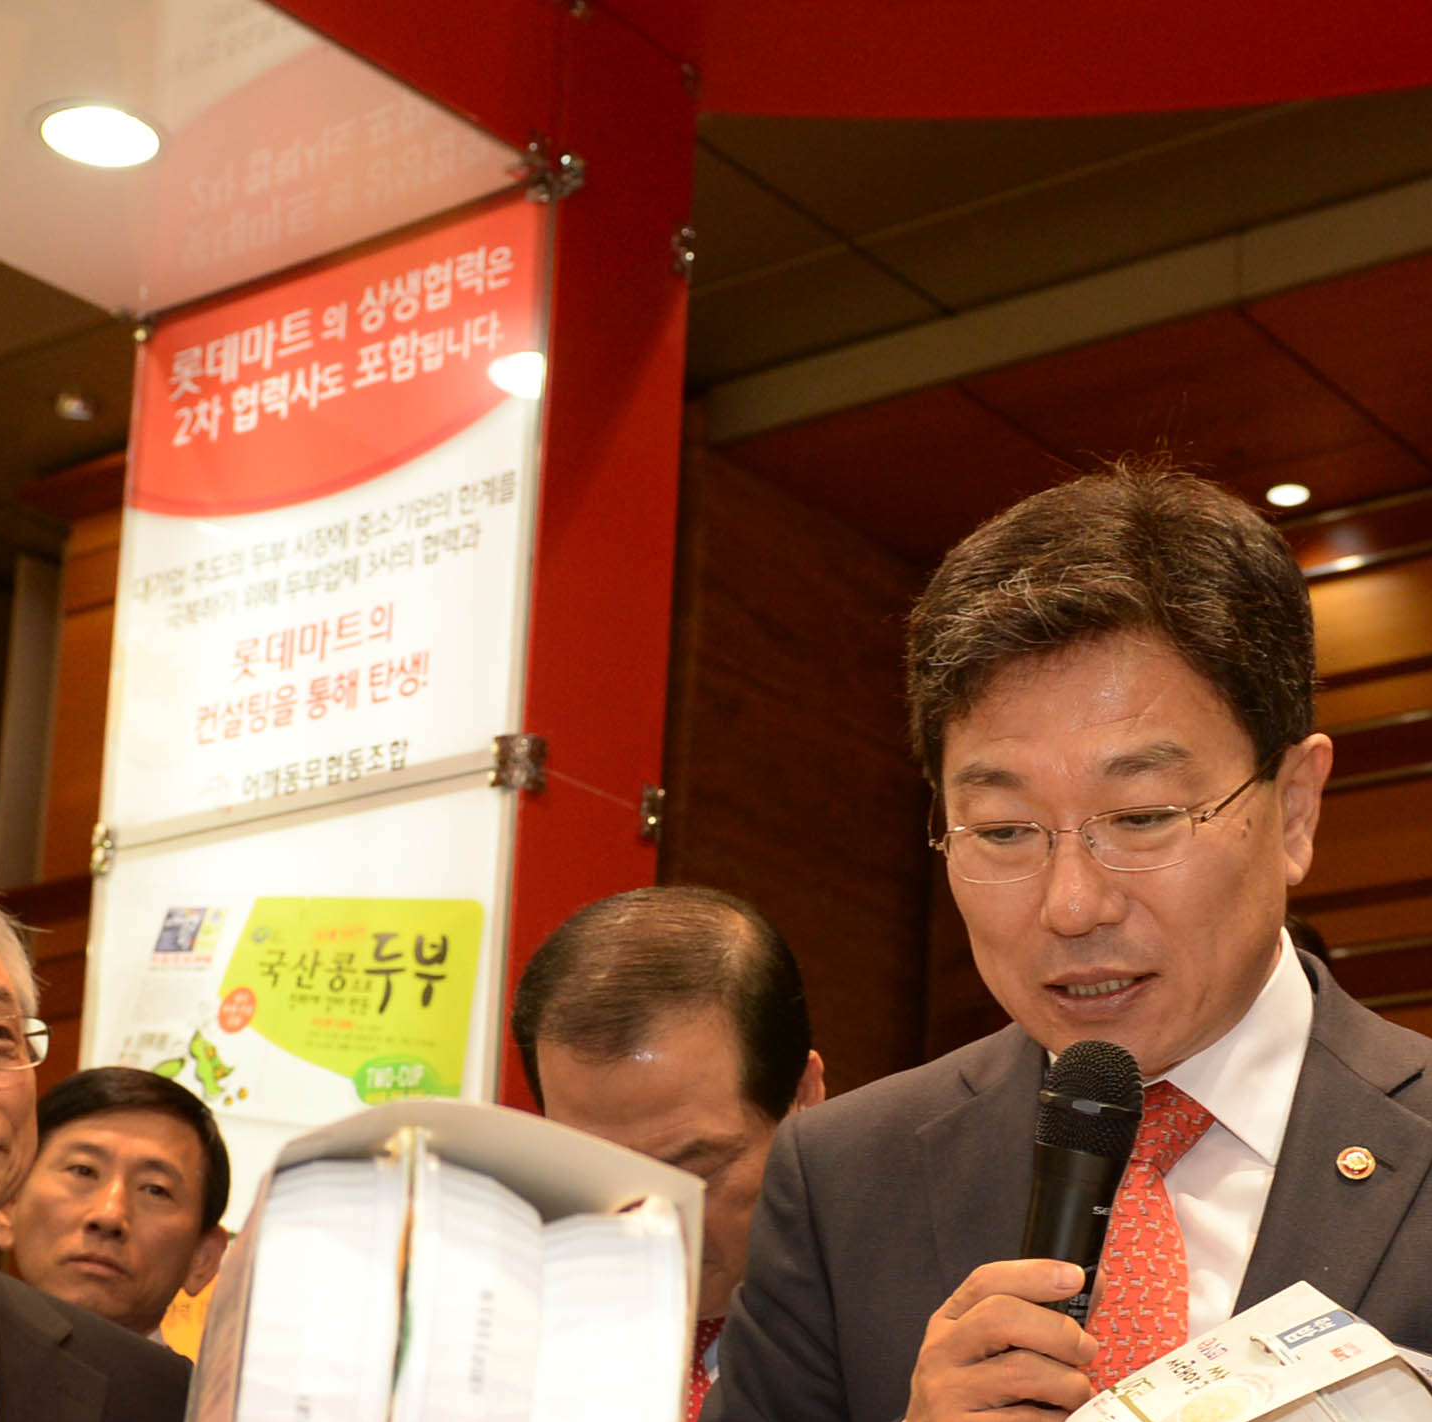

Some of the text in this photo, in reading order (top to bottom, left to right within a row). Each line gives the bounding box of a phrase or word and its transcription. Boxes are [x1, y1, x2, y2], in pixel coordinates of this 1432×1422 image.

[170, 246, 515, 400] 롯데마트 의 상생협력은
[172, 312, 505, 447] 2차 협력사도 포함됩니다.
[232, 602, 396, 684] 롯데마트의
[195, 651, 430, 746] 컨설팅을 통해 탄생!
[364, 932, 449, 1015] 두부
